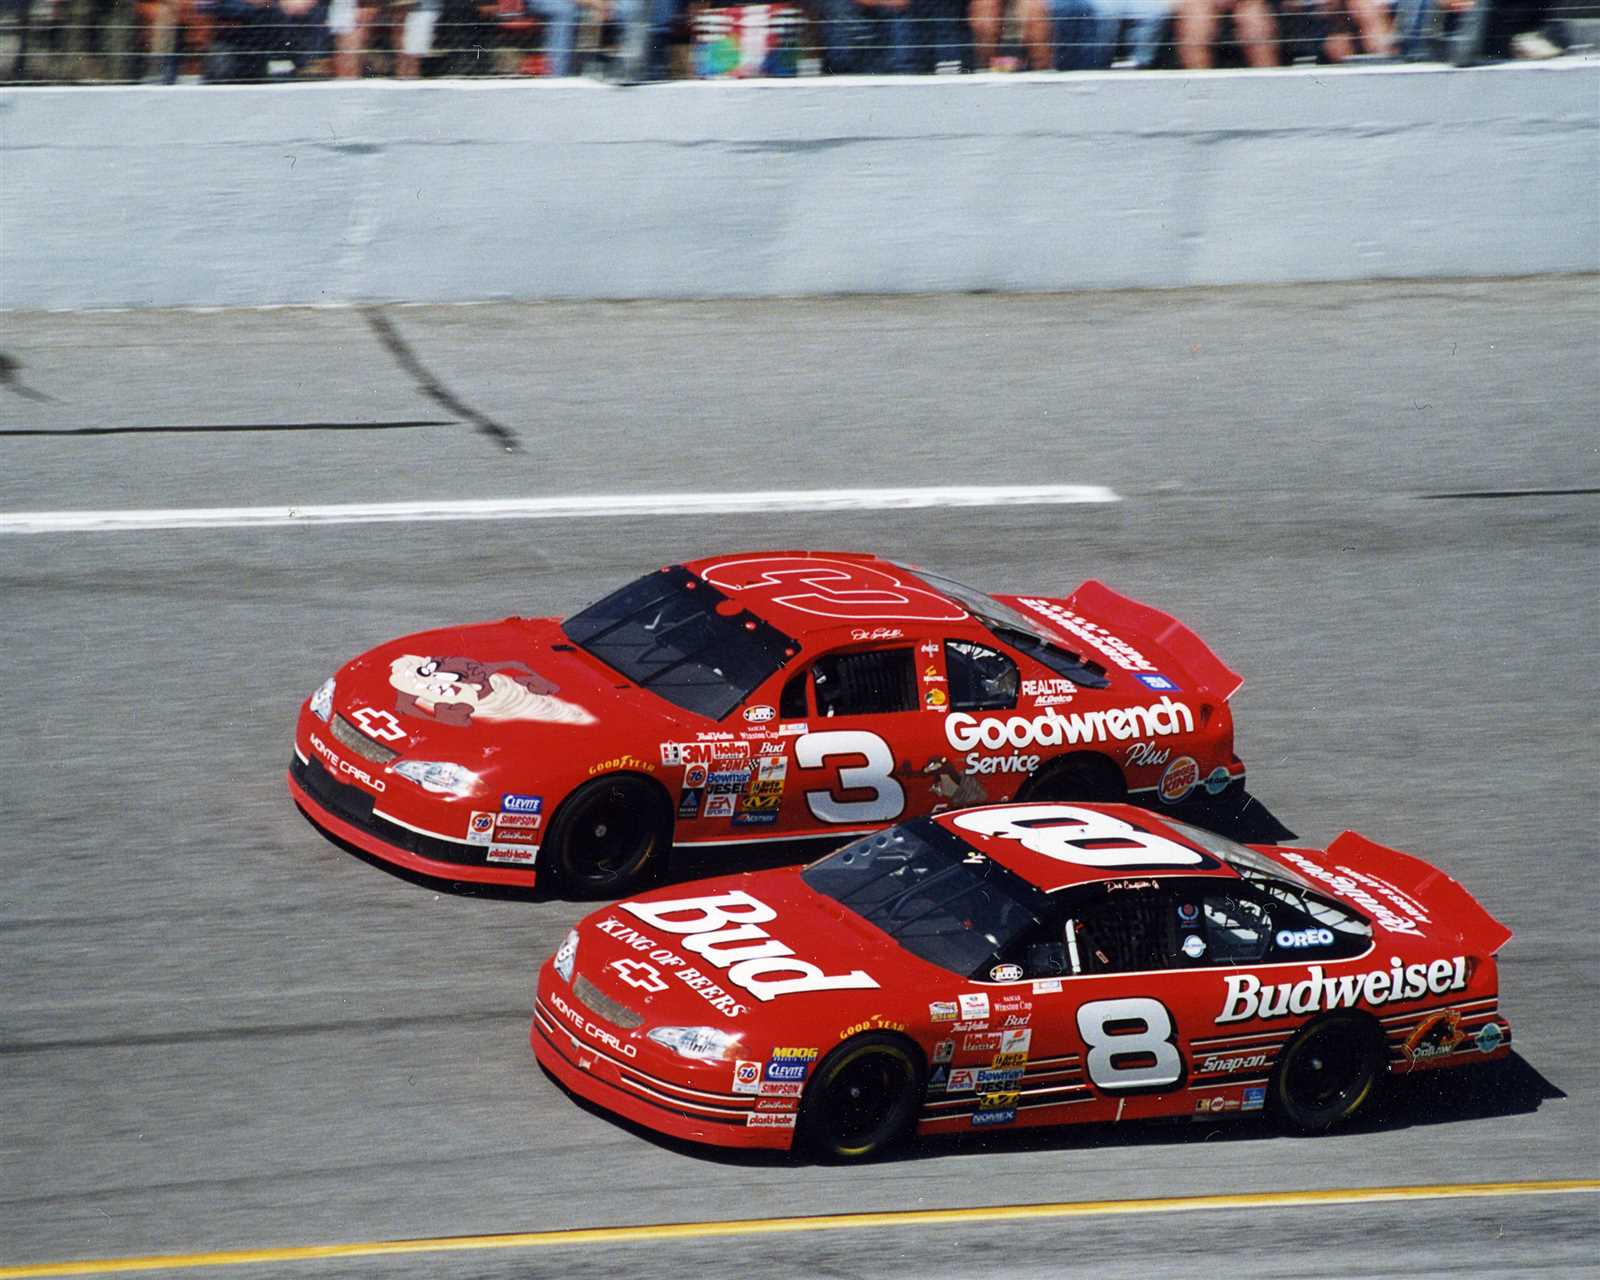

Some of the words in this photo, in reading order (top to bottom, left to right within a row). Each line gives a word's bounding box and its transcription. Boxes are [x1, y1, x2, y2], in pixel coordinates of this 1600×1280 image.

[944, 696, 1195, 752] Goodwrench
[682, 744, 712, 763] 3M
[760, 741, 786, 754] Bud
[1125, 740, 1170, 768] Plus
[310, 732, 339, 766] MONTE
[339, 760, 386, 792] CARLO
[964, 749, 1040, 775] Service
[690, 771, 704, 781] 76
[795, 730, 906, 823] 3
[1165, 775, 1196, 793] KING
[706, 783, 747, 795] JESEL
[504, 795, 540, 811] CLEVITE
[476, 818, 489, 827] 76
[500, 815, 538, 825] SIMPSON
[953, 802, 1203, 866] 8
[1280, 852, 1427, 938] Remington
[619, 890, 881, 1001] Bud
[1275, 929, 1335, 948] OREO
[595, 917, 656, 950] KING
[649, 949, 686, 967] OF
[674, 967, 746, 1018] BEERS
[1214, 955, 1467, 1023] Budweiser
[550, 992, 584, 1028] MONTE
[585, 1022, 637, 1058] CARLO
[1005, 1014, 1031, 1026] Bud
[772, 1047, 818, 1057] MOOG
[1077, 999, 1182, 1090] 8
[768, 1063, 804, 1079] CLEVITE
[1201, 1055, 1266, 1072] Snap-on
[741, 1068, 754, 1078] 76
[977, 1070, 1024, 1082] Bowman
[762, 1084, 801, 1095] SIMPSON
[972, 1112, 1014, 1123] NOMEX
